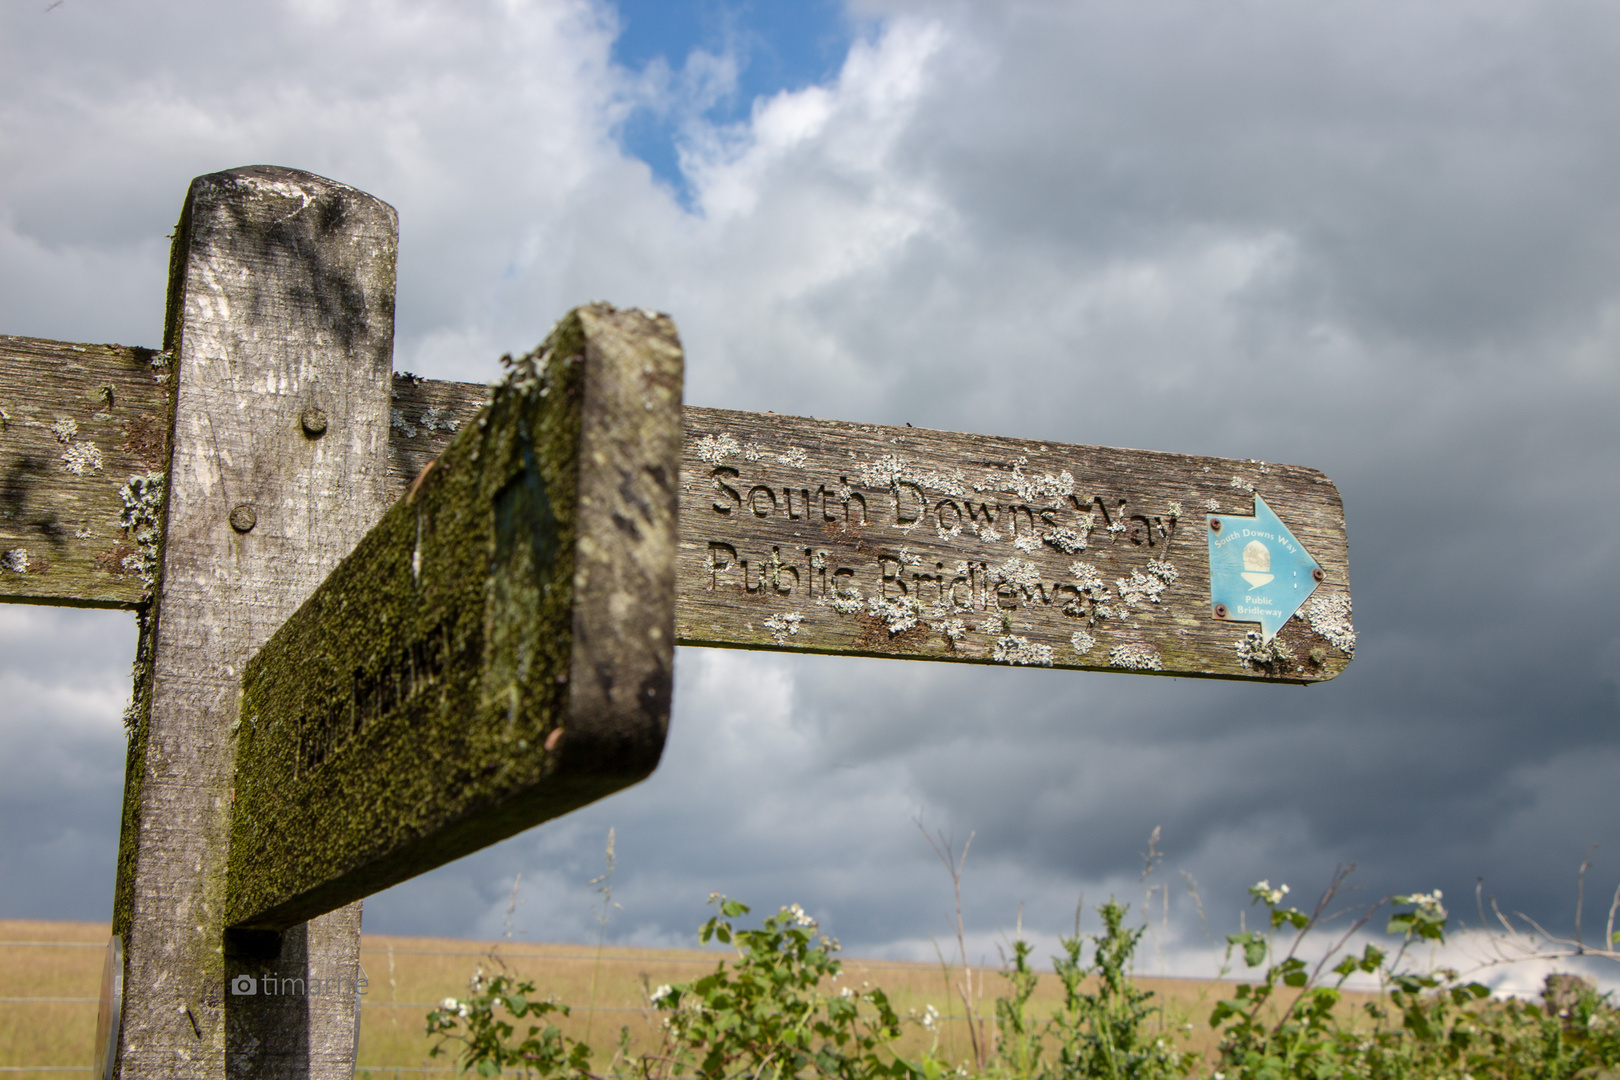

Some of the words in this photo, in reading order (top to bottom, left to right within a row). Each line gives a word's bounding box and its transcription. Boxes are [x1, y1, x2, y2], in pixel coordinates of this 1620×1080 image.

[711, 465, 868, 524] South
[891, 480, 1062, 548] Downs
[1068, 495, 1178, 562] Way
[1215, 530, 1241, 549] South
[1242, 528, 1275, 541] Downs
[1277, 535, 1298, 554] Way
[706, 541, 857, 606] Public
[1237, 605, 1283, 618] Bridleway
[1245, 595, 1273, 606] Public
